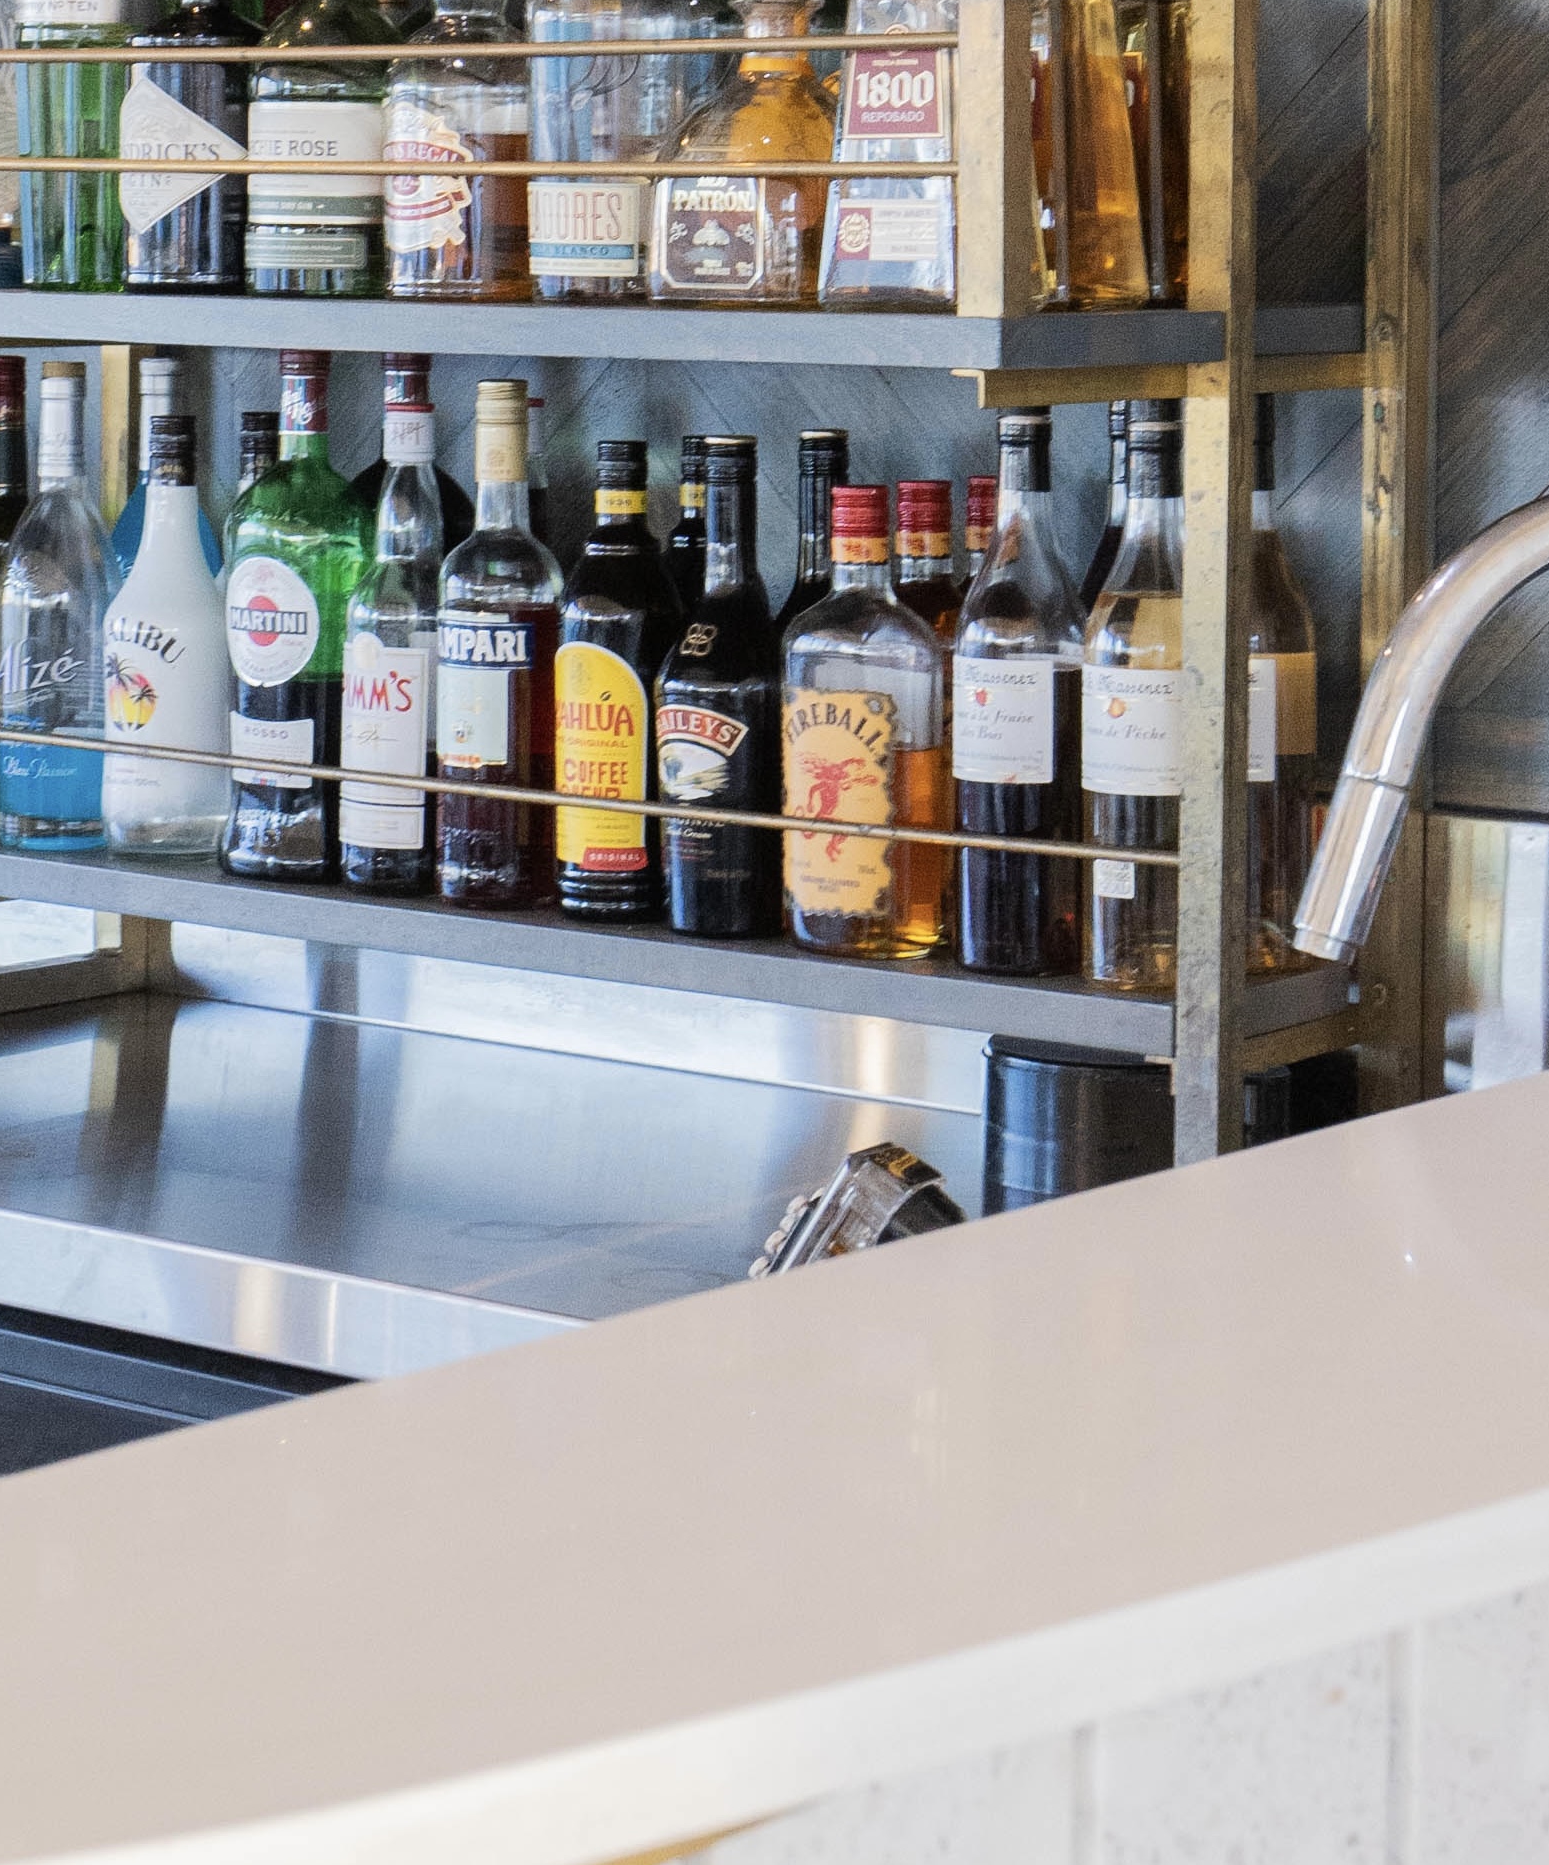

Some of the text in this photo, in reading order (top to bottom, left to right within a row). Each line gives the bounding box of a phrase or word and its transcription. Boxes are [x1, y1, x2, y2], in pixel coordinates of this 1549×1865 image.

[67, 0, 99, 13] TEN
[855, 69, 936, 109] 1800
[860, 110, 925, 124] REPOSADO
[287, 140, 340, 157] ROSE
[672, 185, 755, 213] PATRÓN
[531, 190, 623, 242] ADORES
[230, 606, 307, 634] MARTINI
[108, 616, 187, 665] ALIBU
[438, 626, 527, 663] AMPARI
[658, 711, 737, 743] AILEYS
[563, 758, 630, 785] COFFEE
